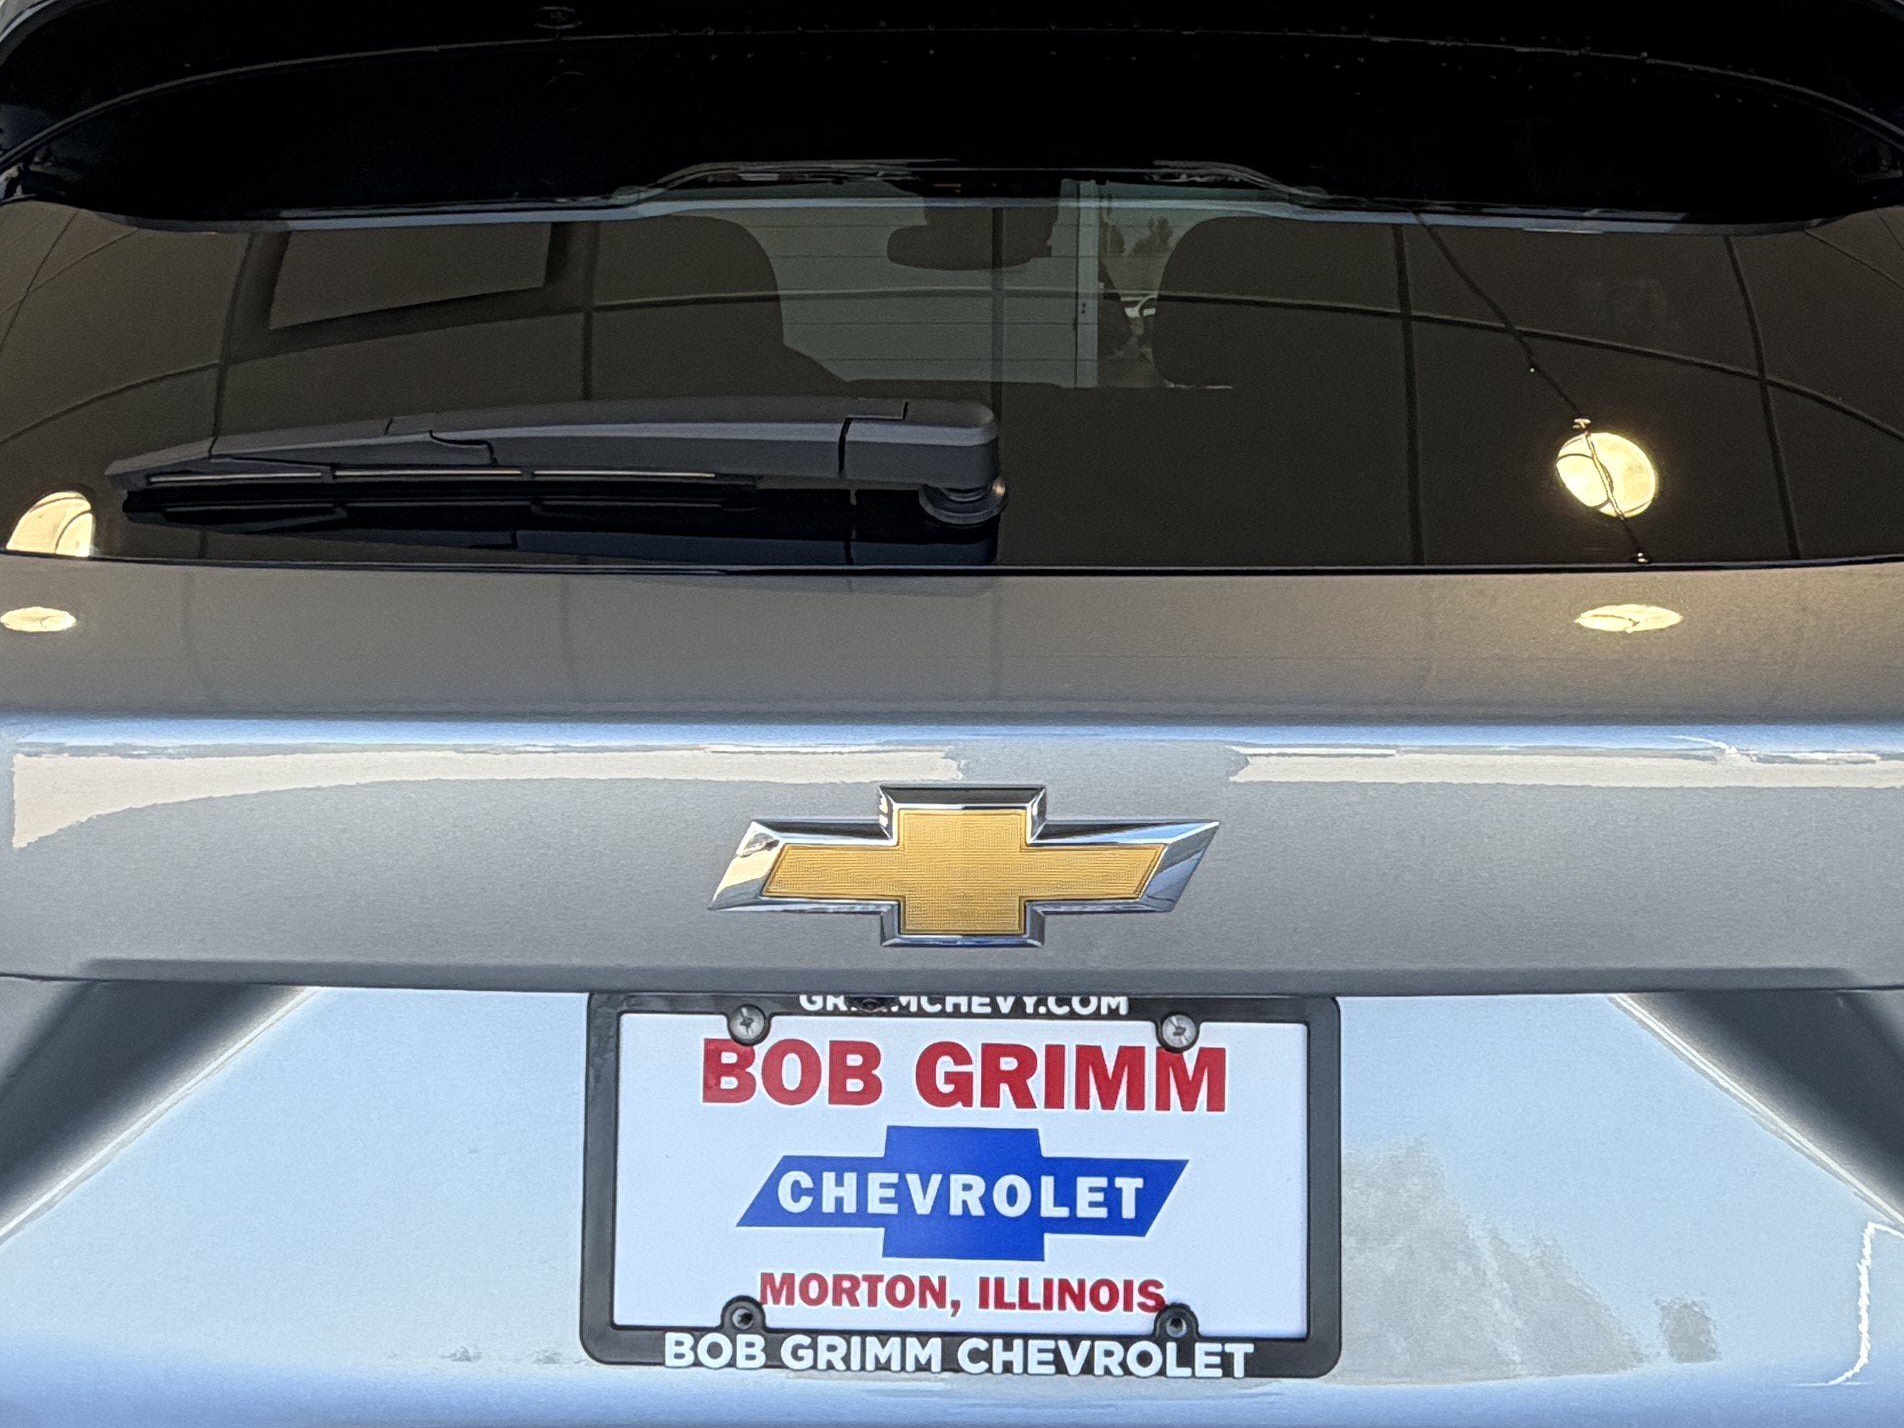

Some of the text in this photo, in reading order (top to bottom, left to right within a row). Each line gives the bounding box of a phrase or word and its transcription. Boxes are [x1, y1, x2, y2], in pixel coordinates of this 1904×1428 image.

[702, 1038, 1228, 1114] BOB GRIMM
[777, 1172, 1146, 1220] CHEVROLET
[759, 1272, 1166, 1319] MORTON, ILLINOIS
[663, 1332, 1255, 1379] BOB GRIMM CHEVROLET
